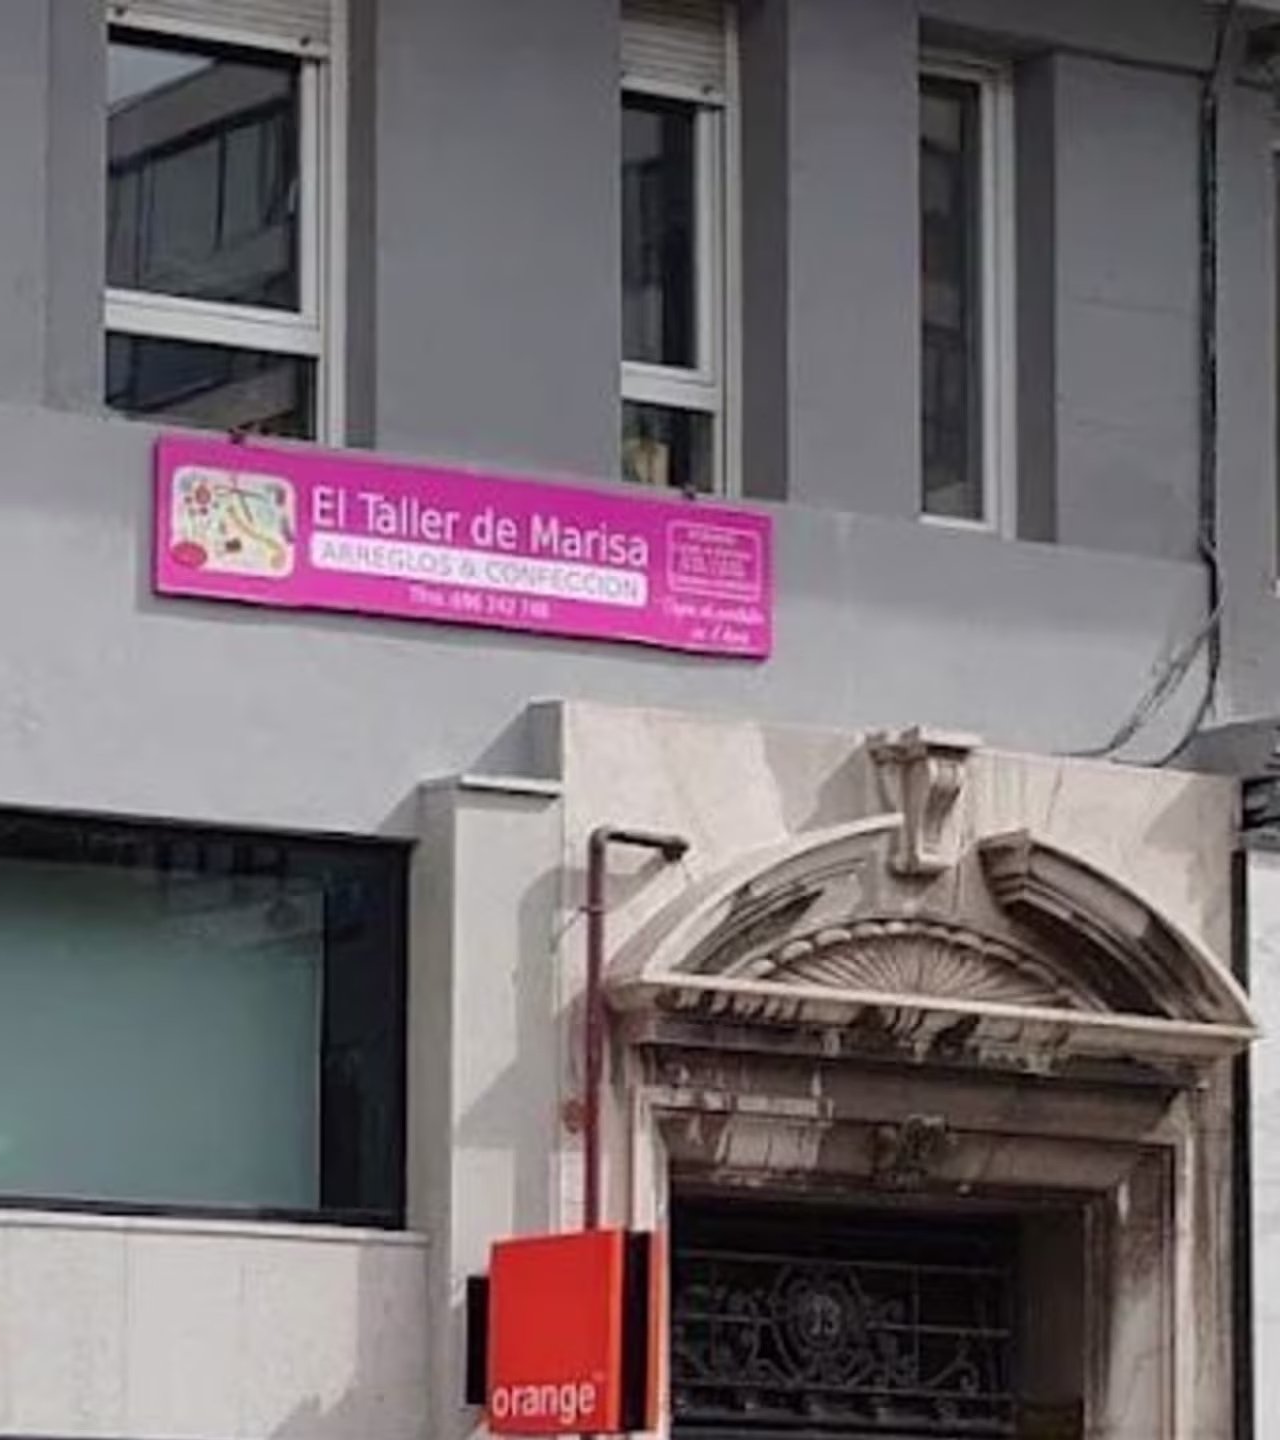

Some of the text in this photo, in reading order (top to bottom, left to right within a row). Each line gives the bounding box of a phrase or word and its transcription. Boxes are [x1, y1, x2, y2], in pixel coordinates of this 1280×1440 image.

[312, 486, 346, 528] El
[358, 492, 460, 541] Taller
[471, 506, 518, 550] de
[530, 514, 649, 566] Marisa
[321, 540, 453, 577] ARREGLOS
[492, 1381, 596, 1425] orange
